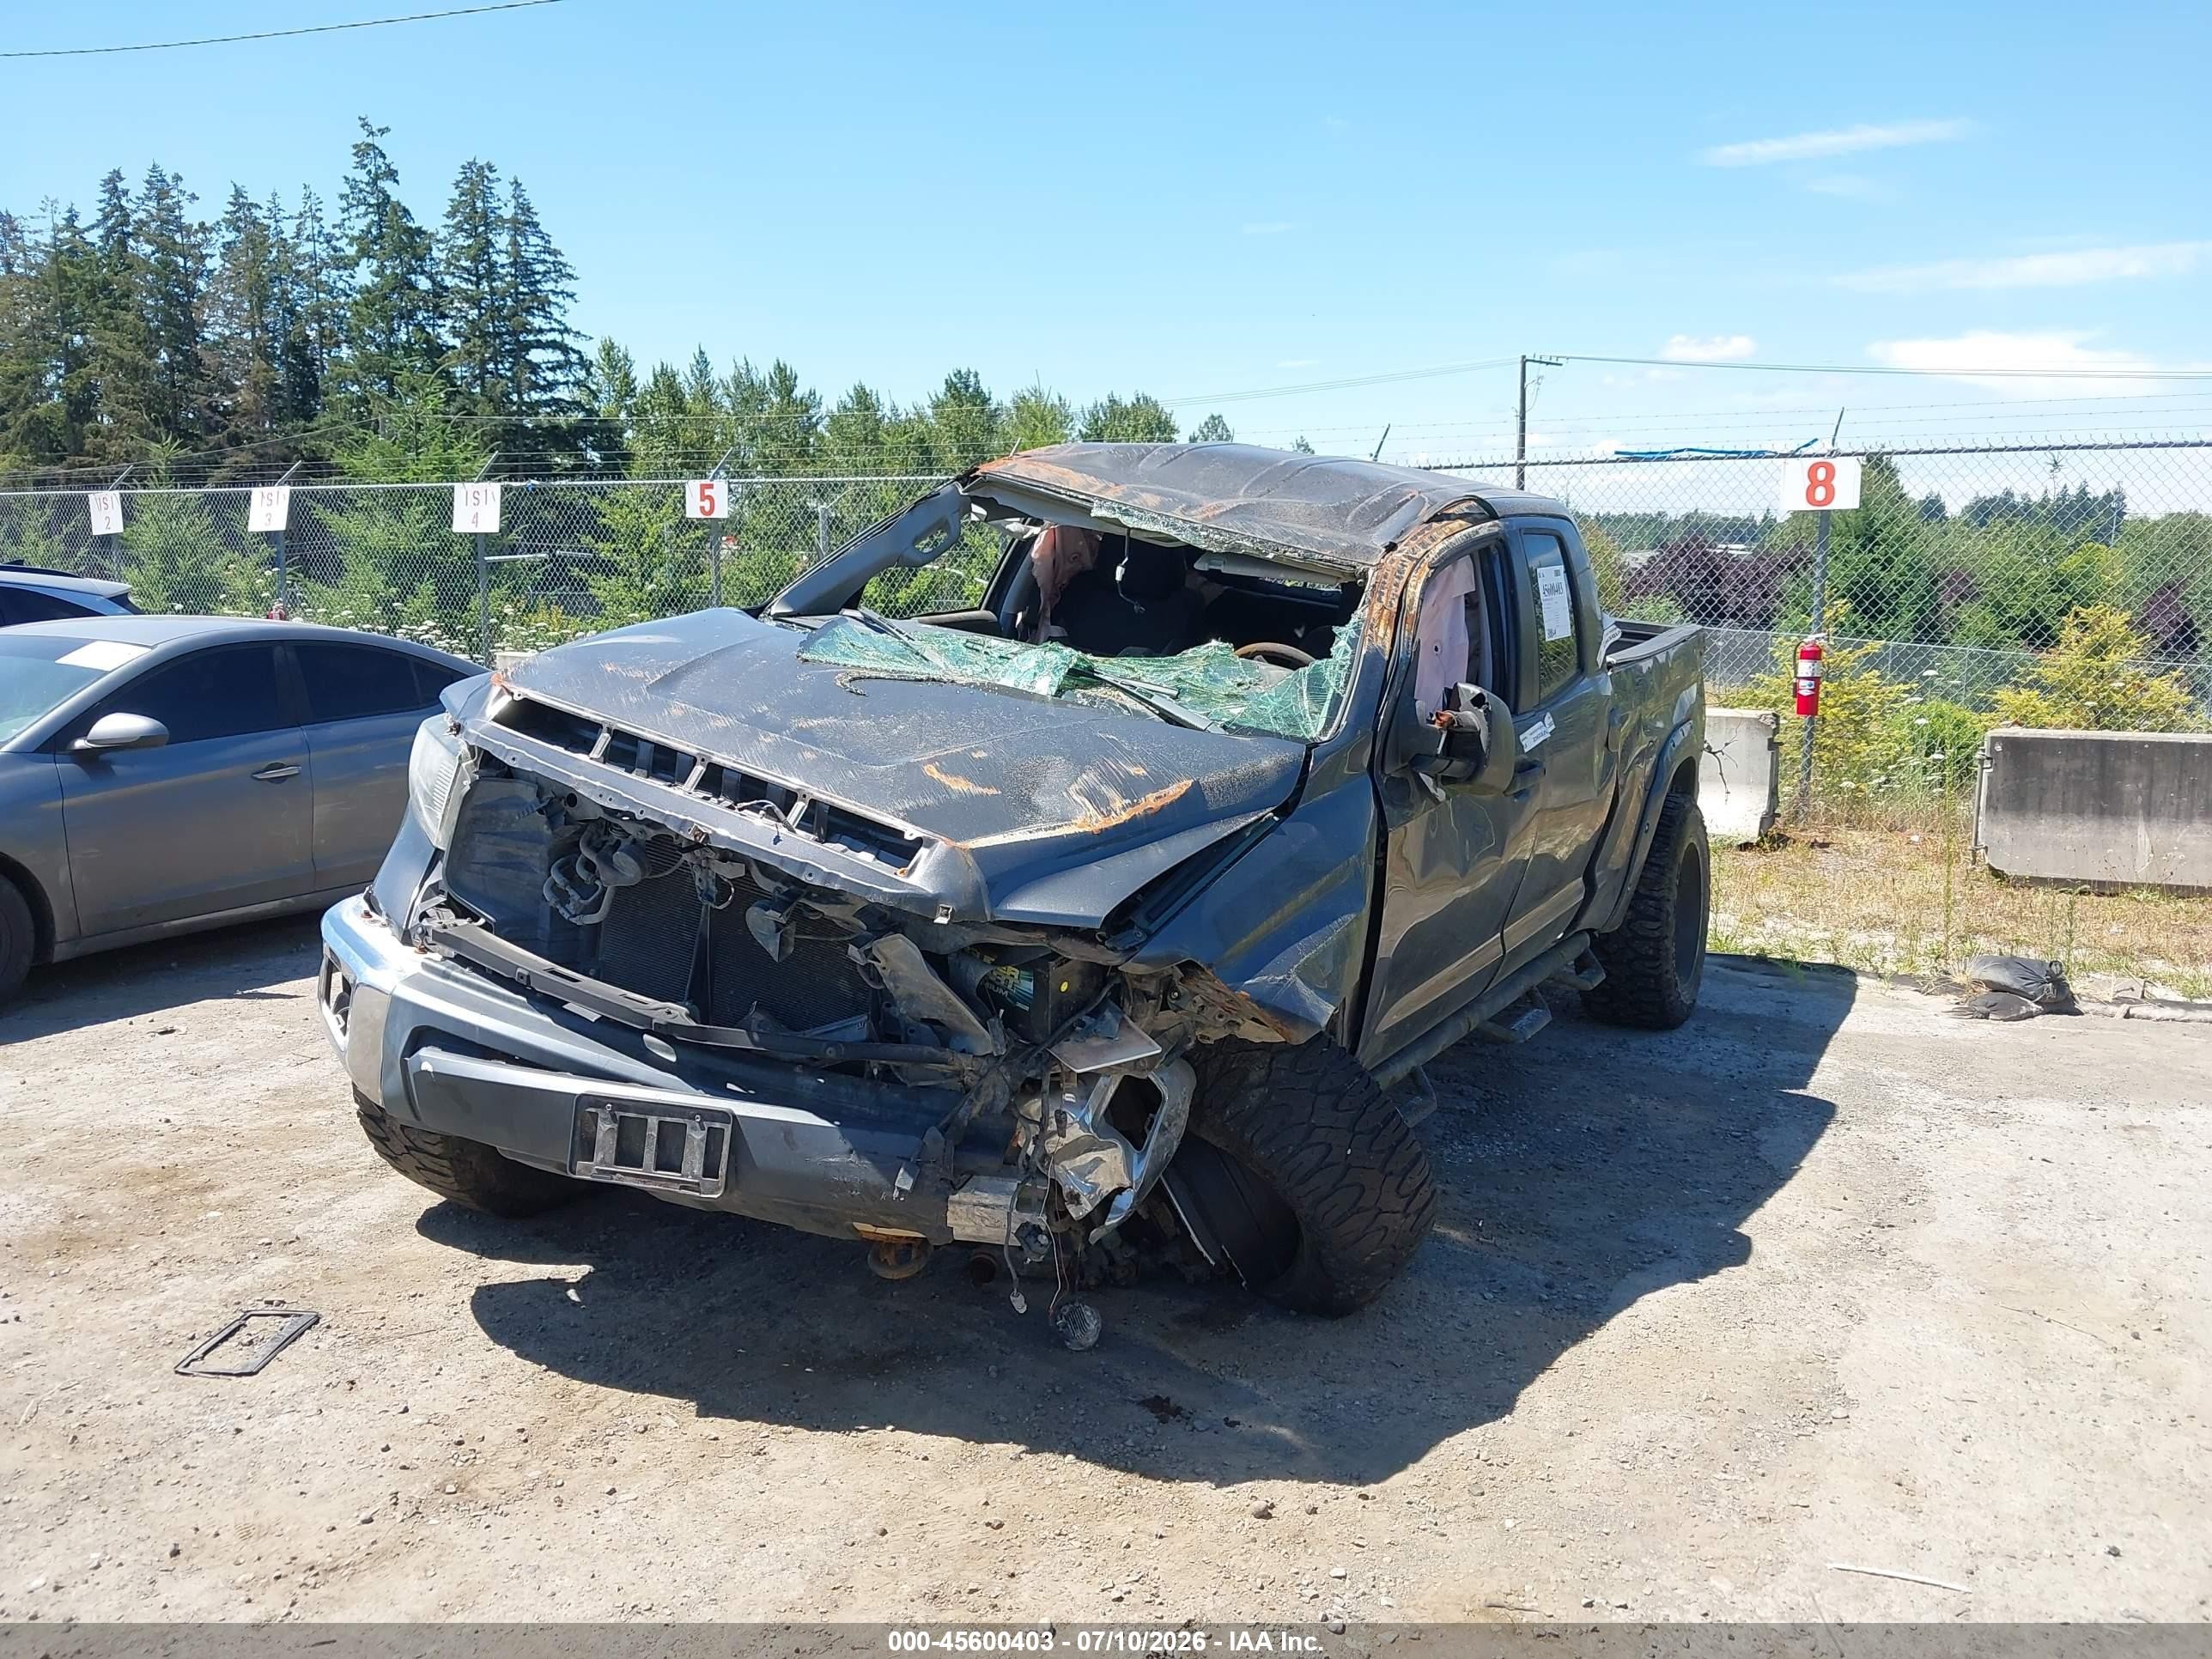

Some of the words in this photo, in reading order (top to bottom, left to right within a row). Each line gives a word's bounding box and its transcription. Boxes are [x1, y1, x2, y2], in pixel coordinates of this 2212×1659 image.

[1806, 461, 1836, 507] 8
[699, 483, 715, 516] 5
[105, 515, 112, 530] 2
[264, 512, 272, 526] 3
[471, 511, 479, 528] 4
